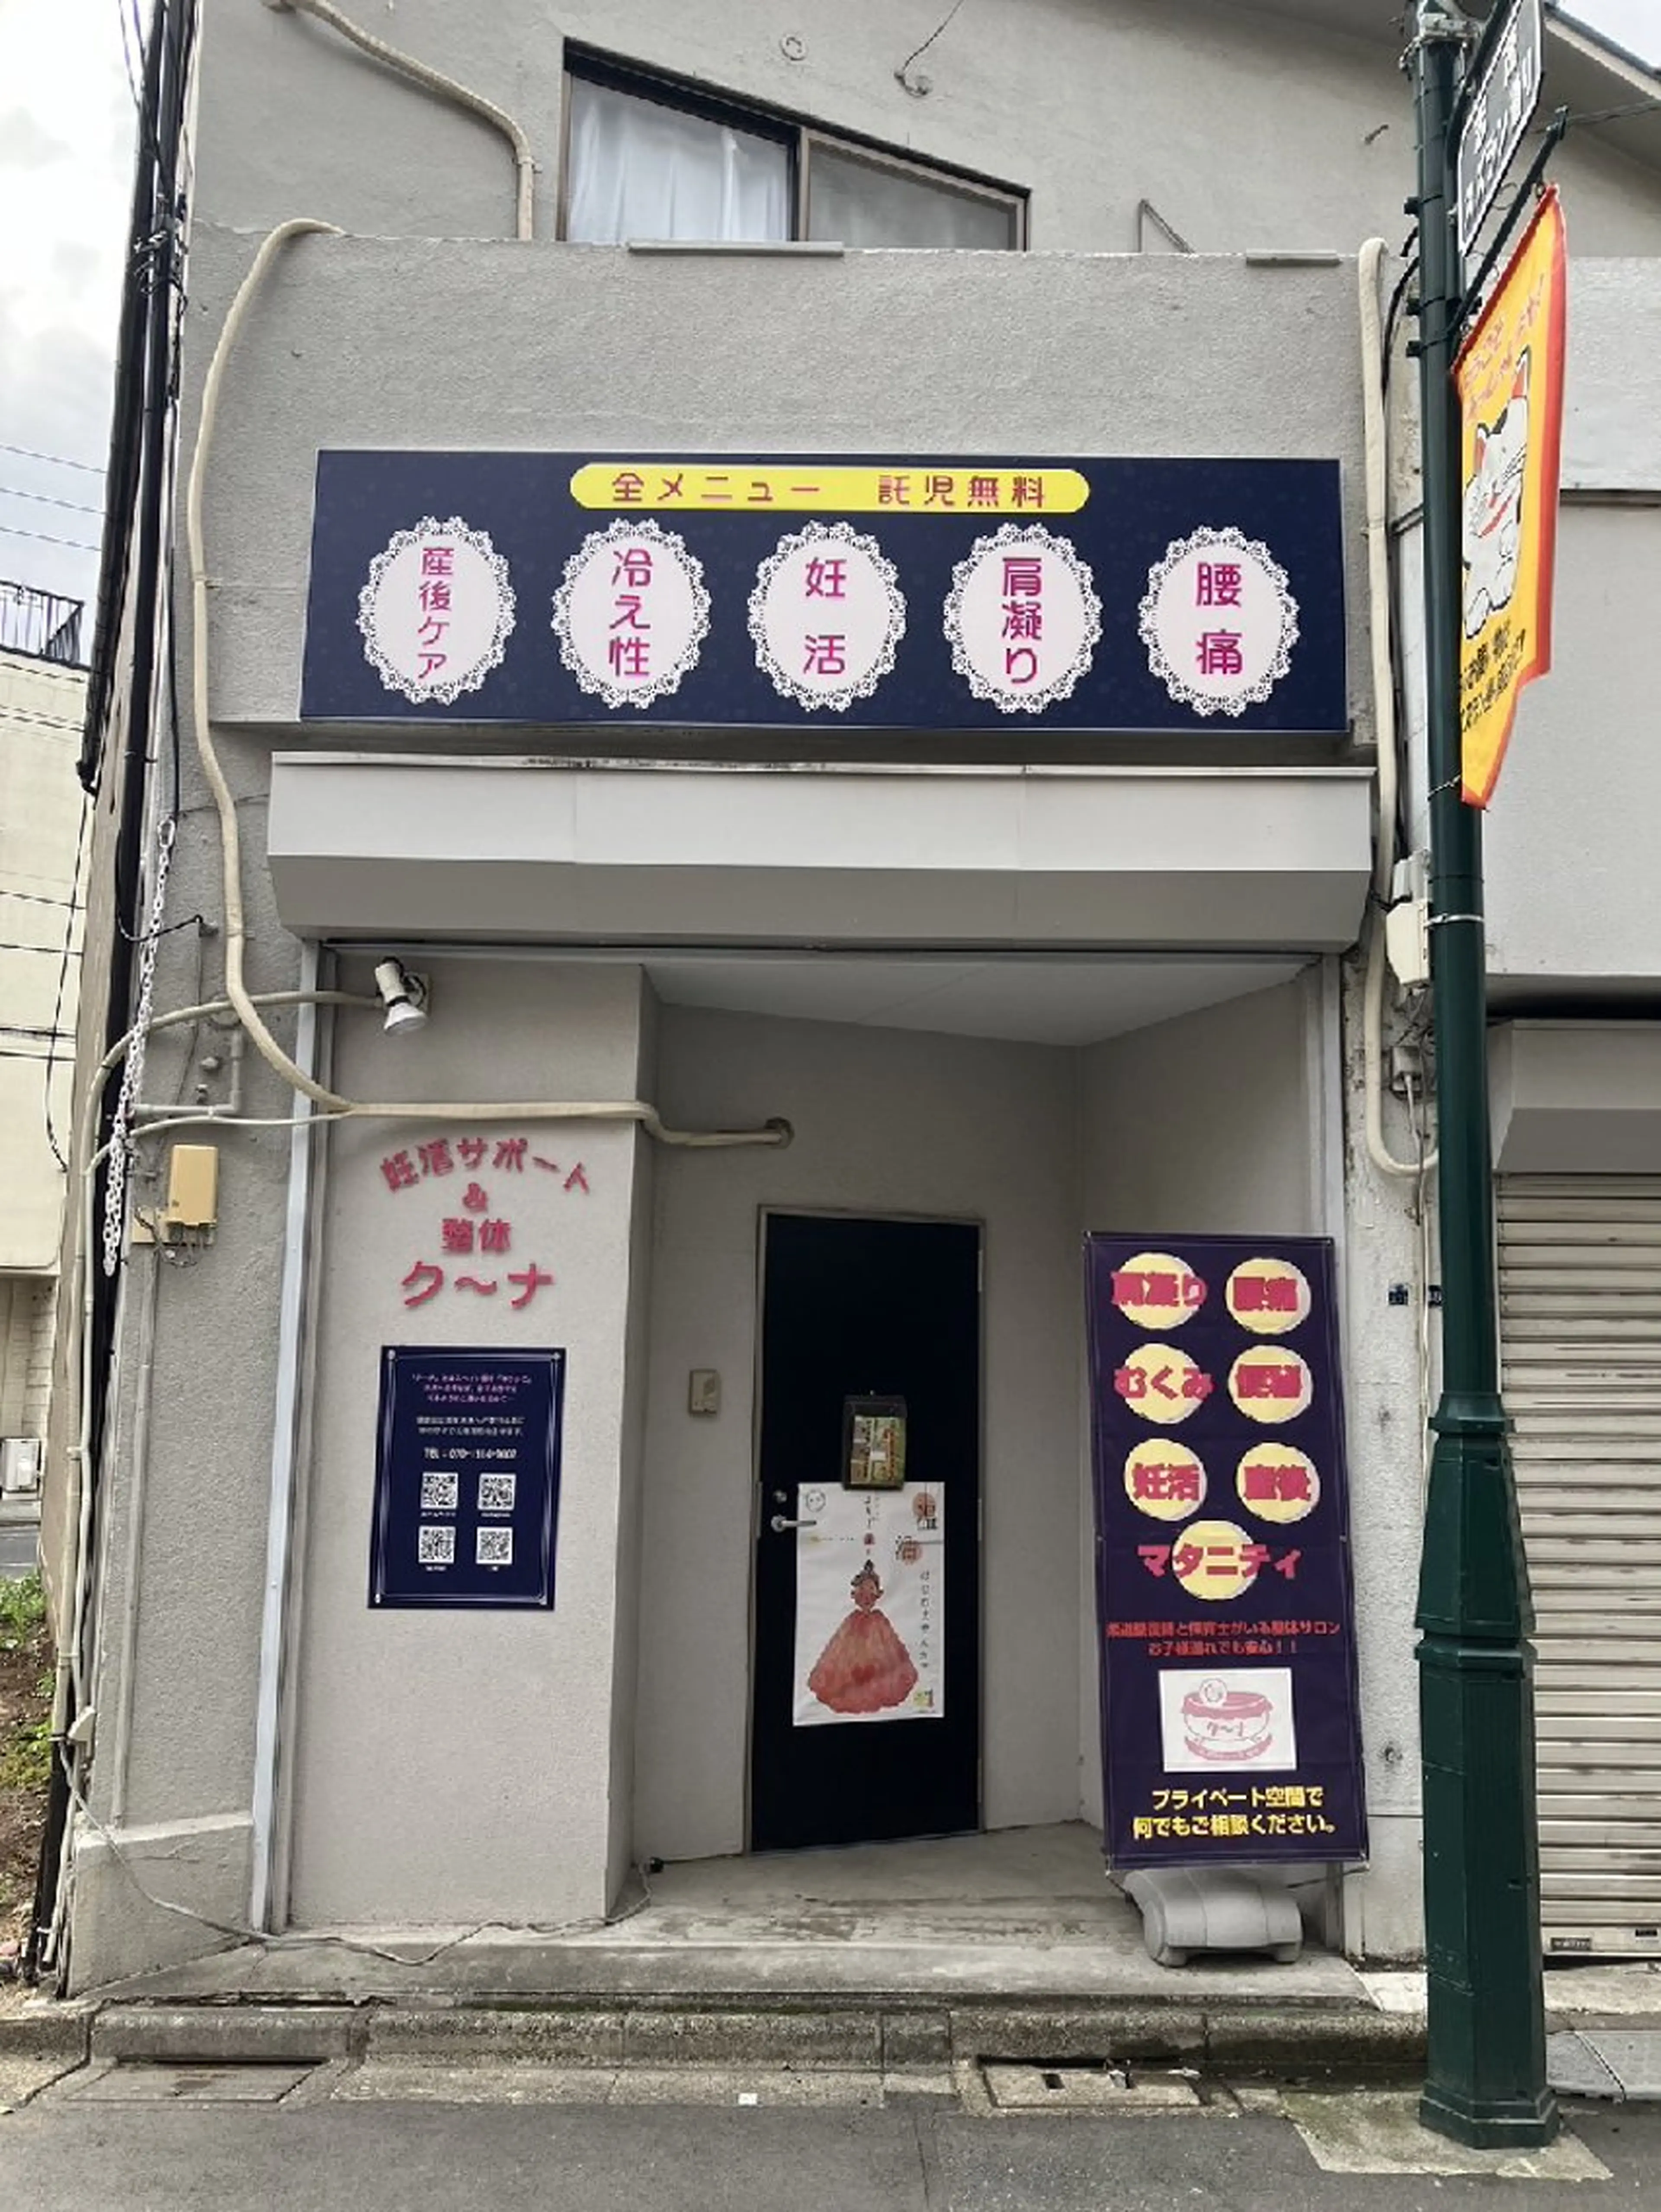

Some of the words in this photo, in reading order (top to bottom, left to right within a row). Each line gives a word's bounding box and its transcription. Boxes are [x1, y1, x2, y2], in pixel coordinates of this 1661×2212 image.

[612, 472, 820, 503] 全メニュー
[878, 475, 1045, 508] 託児無料
[417, 547, 455, 679] 産後ケア
[608, 548, 653, 677] 冷え性
[803, 557, 847, 675] 妊活
[1001, 557, 1042, 684] 肩凝り
[1195, 562, 1243, 675] 腰痛
[441, 1218, 512, 1253] 整体
[1113, 1365, 1213, 1401] むくみ
[1132, 1462, 1200, 1502] 妊活
[1138, 1543, 1301, 1579] マタニティ
[1152, 1786, 1324, 1809] プライベート空間で
[1132, 1813, 1336, 1839] 何でもご相談ください。
